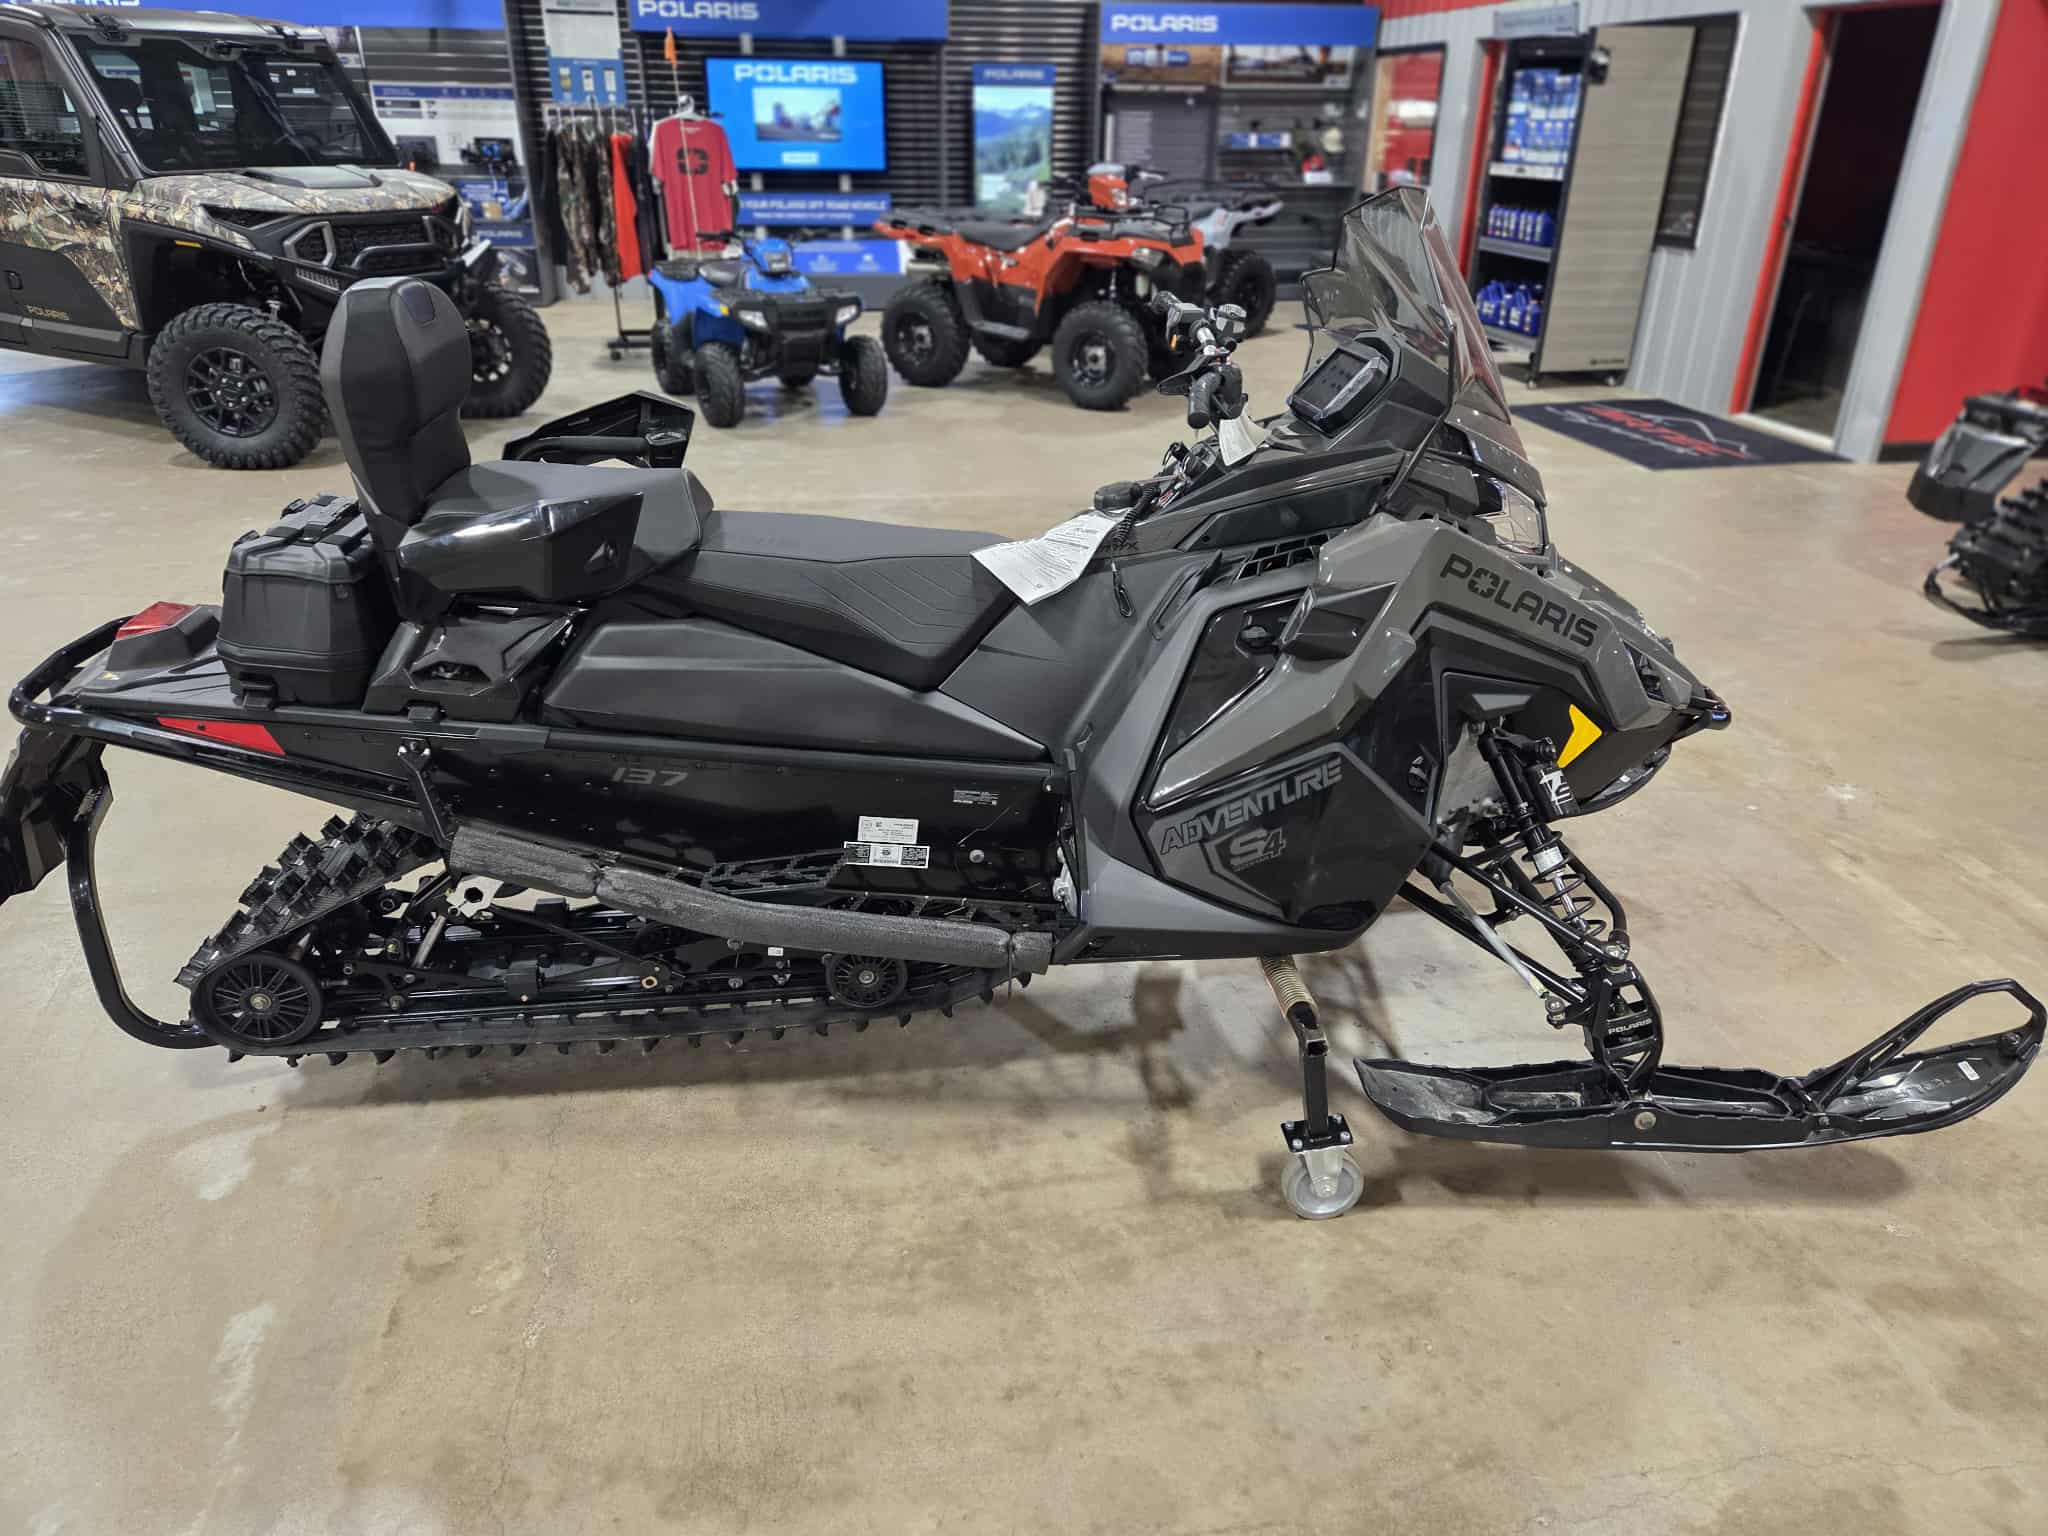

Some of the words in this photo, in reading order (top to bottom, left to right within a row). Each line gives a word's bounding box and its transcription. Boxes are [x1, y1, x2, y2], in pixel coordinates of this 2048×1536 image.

[638, 0, 759, 20] POLARIS
[1111, 14, 1218, 33] POLARIS
[734, 63, 858, 85] POLARIS
[983, 68, 1045, 81] POLARIS
[1439, 553, 1598, 648] POLARIS
[613, 767, 689, 786] 137
[1159, 757, 1343, 855] ADVENTURE
[1607, 1018, 1653, 1035] POLARIS
